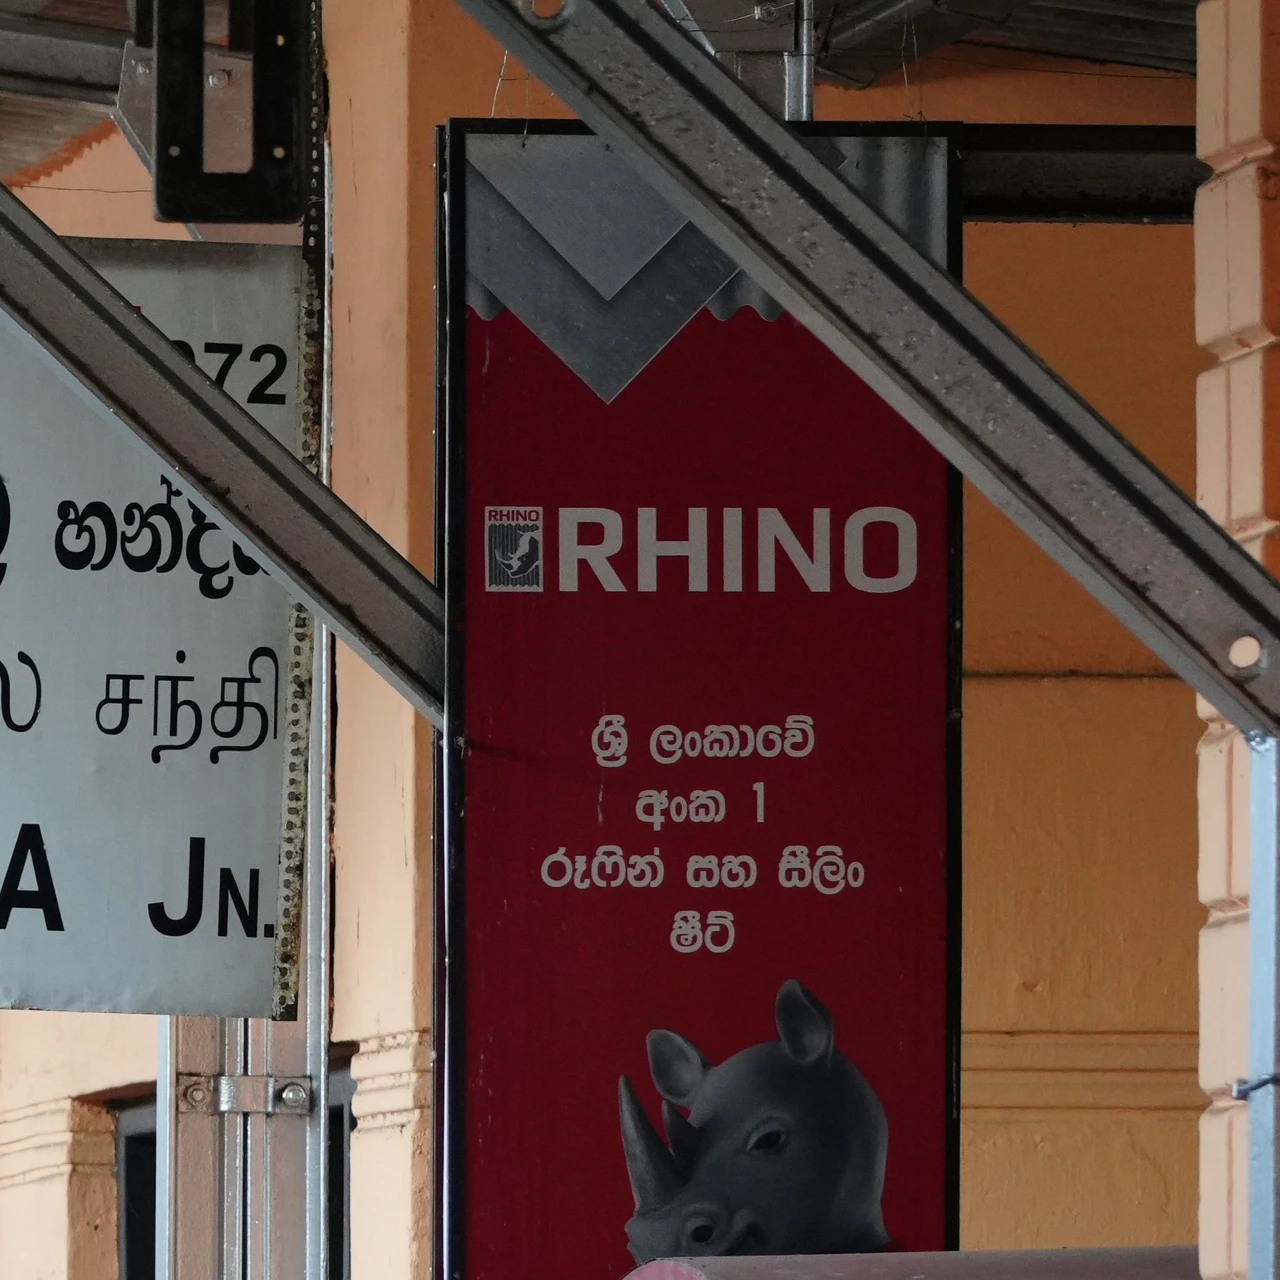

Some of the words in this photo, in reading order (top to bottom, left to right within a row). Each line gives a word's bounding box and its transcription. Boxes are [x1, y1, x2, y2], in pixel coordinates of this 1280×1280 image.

[170, 339, 287, 405] 72
[488, 509, 539, 522] RHINO
[558, 506, 918, 594] RHINO
[95, 646, 279, 765] சந்தி
[649, 714, 815, 765] ලංකාවේ
[635, 789, 726, 832] අංක
[752, 781, 765, 823] 1
[686, 854, 758, 888] සහ
